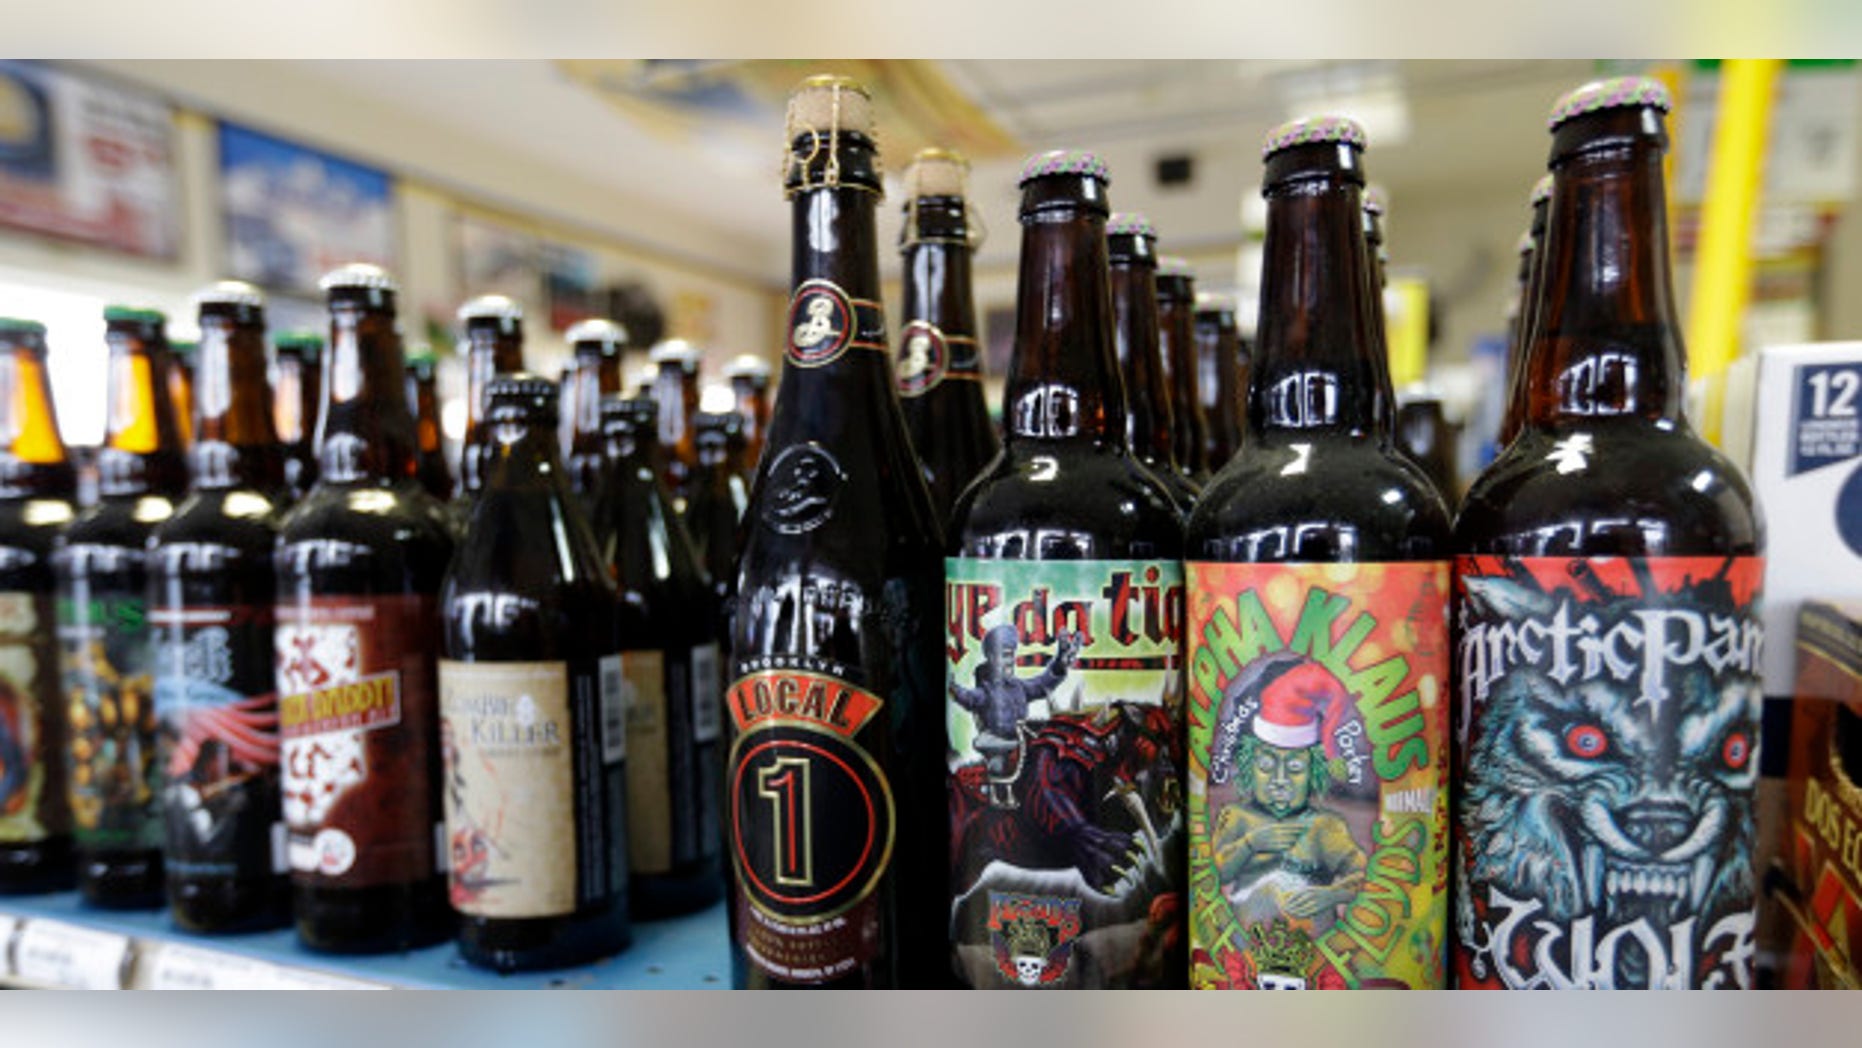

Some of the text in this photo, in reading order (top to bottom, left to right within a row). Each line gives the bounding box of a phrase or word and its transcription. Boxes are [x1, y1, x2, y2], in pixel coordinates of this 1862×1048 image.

[1807, 371, 1860, 417] 12
[1013, 587, 1098, 647] da
[741, 656, 845, 676] BROOKLYN
[1188, 586, 1285, 771] ALPHA
[1290, 586, 1430, 781] KLAUS
[737, 677, 852, 730] LOCAL
[758, 756, 813, 887] 1
[1804, 777, 1839, 850] DOS
[1317, 820, 1427, 989] FLOYDS
